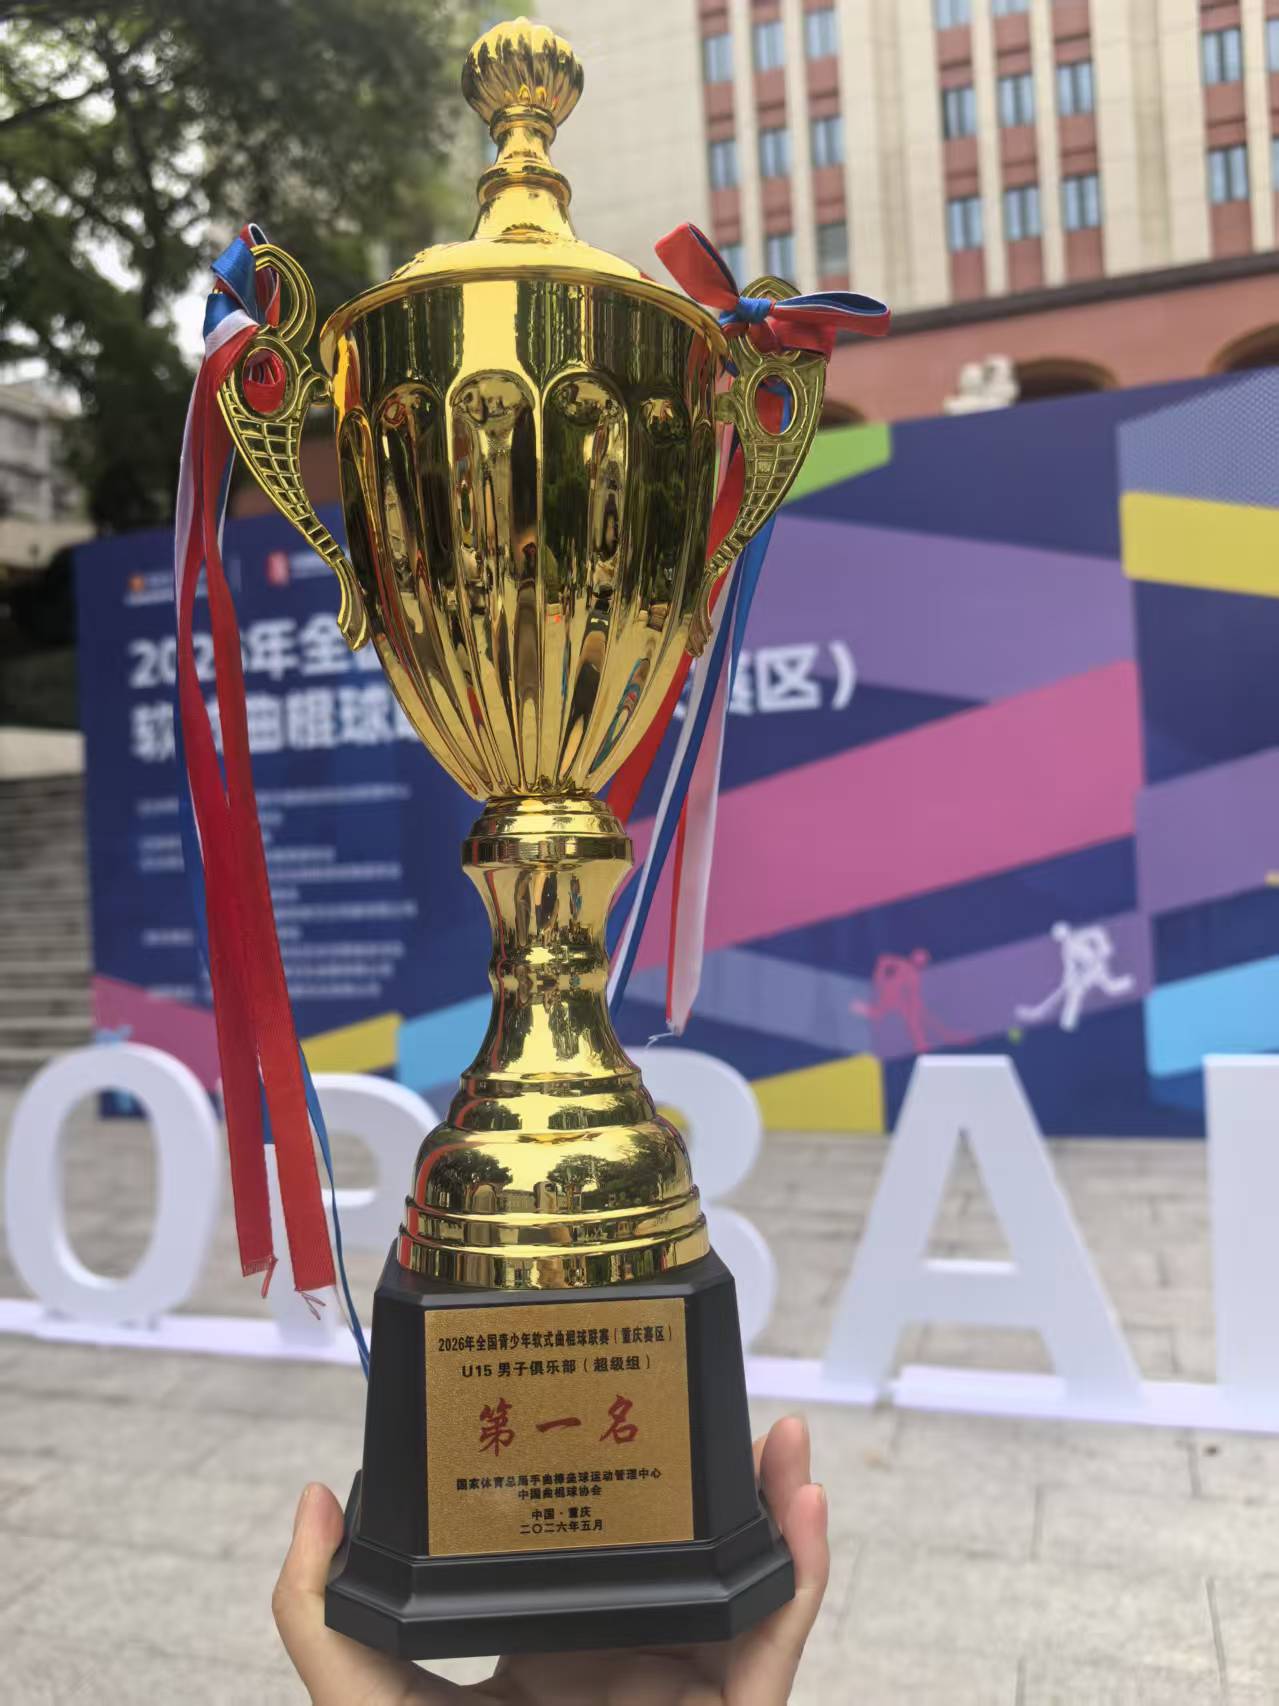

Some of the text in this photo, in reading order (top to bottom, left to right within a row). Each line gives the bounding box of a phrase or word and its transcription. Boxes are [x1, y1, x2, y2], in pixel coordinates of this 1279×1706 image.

[129, 612, 383, 690] 202年全
[462, 1364, 492, 1377] U15
[478, 1394, 639, 1457] 第一名
[518, 1484, 602, 1500] 中国曲棍球协会
